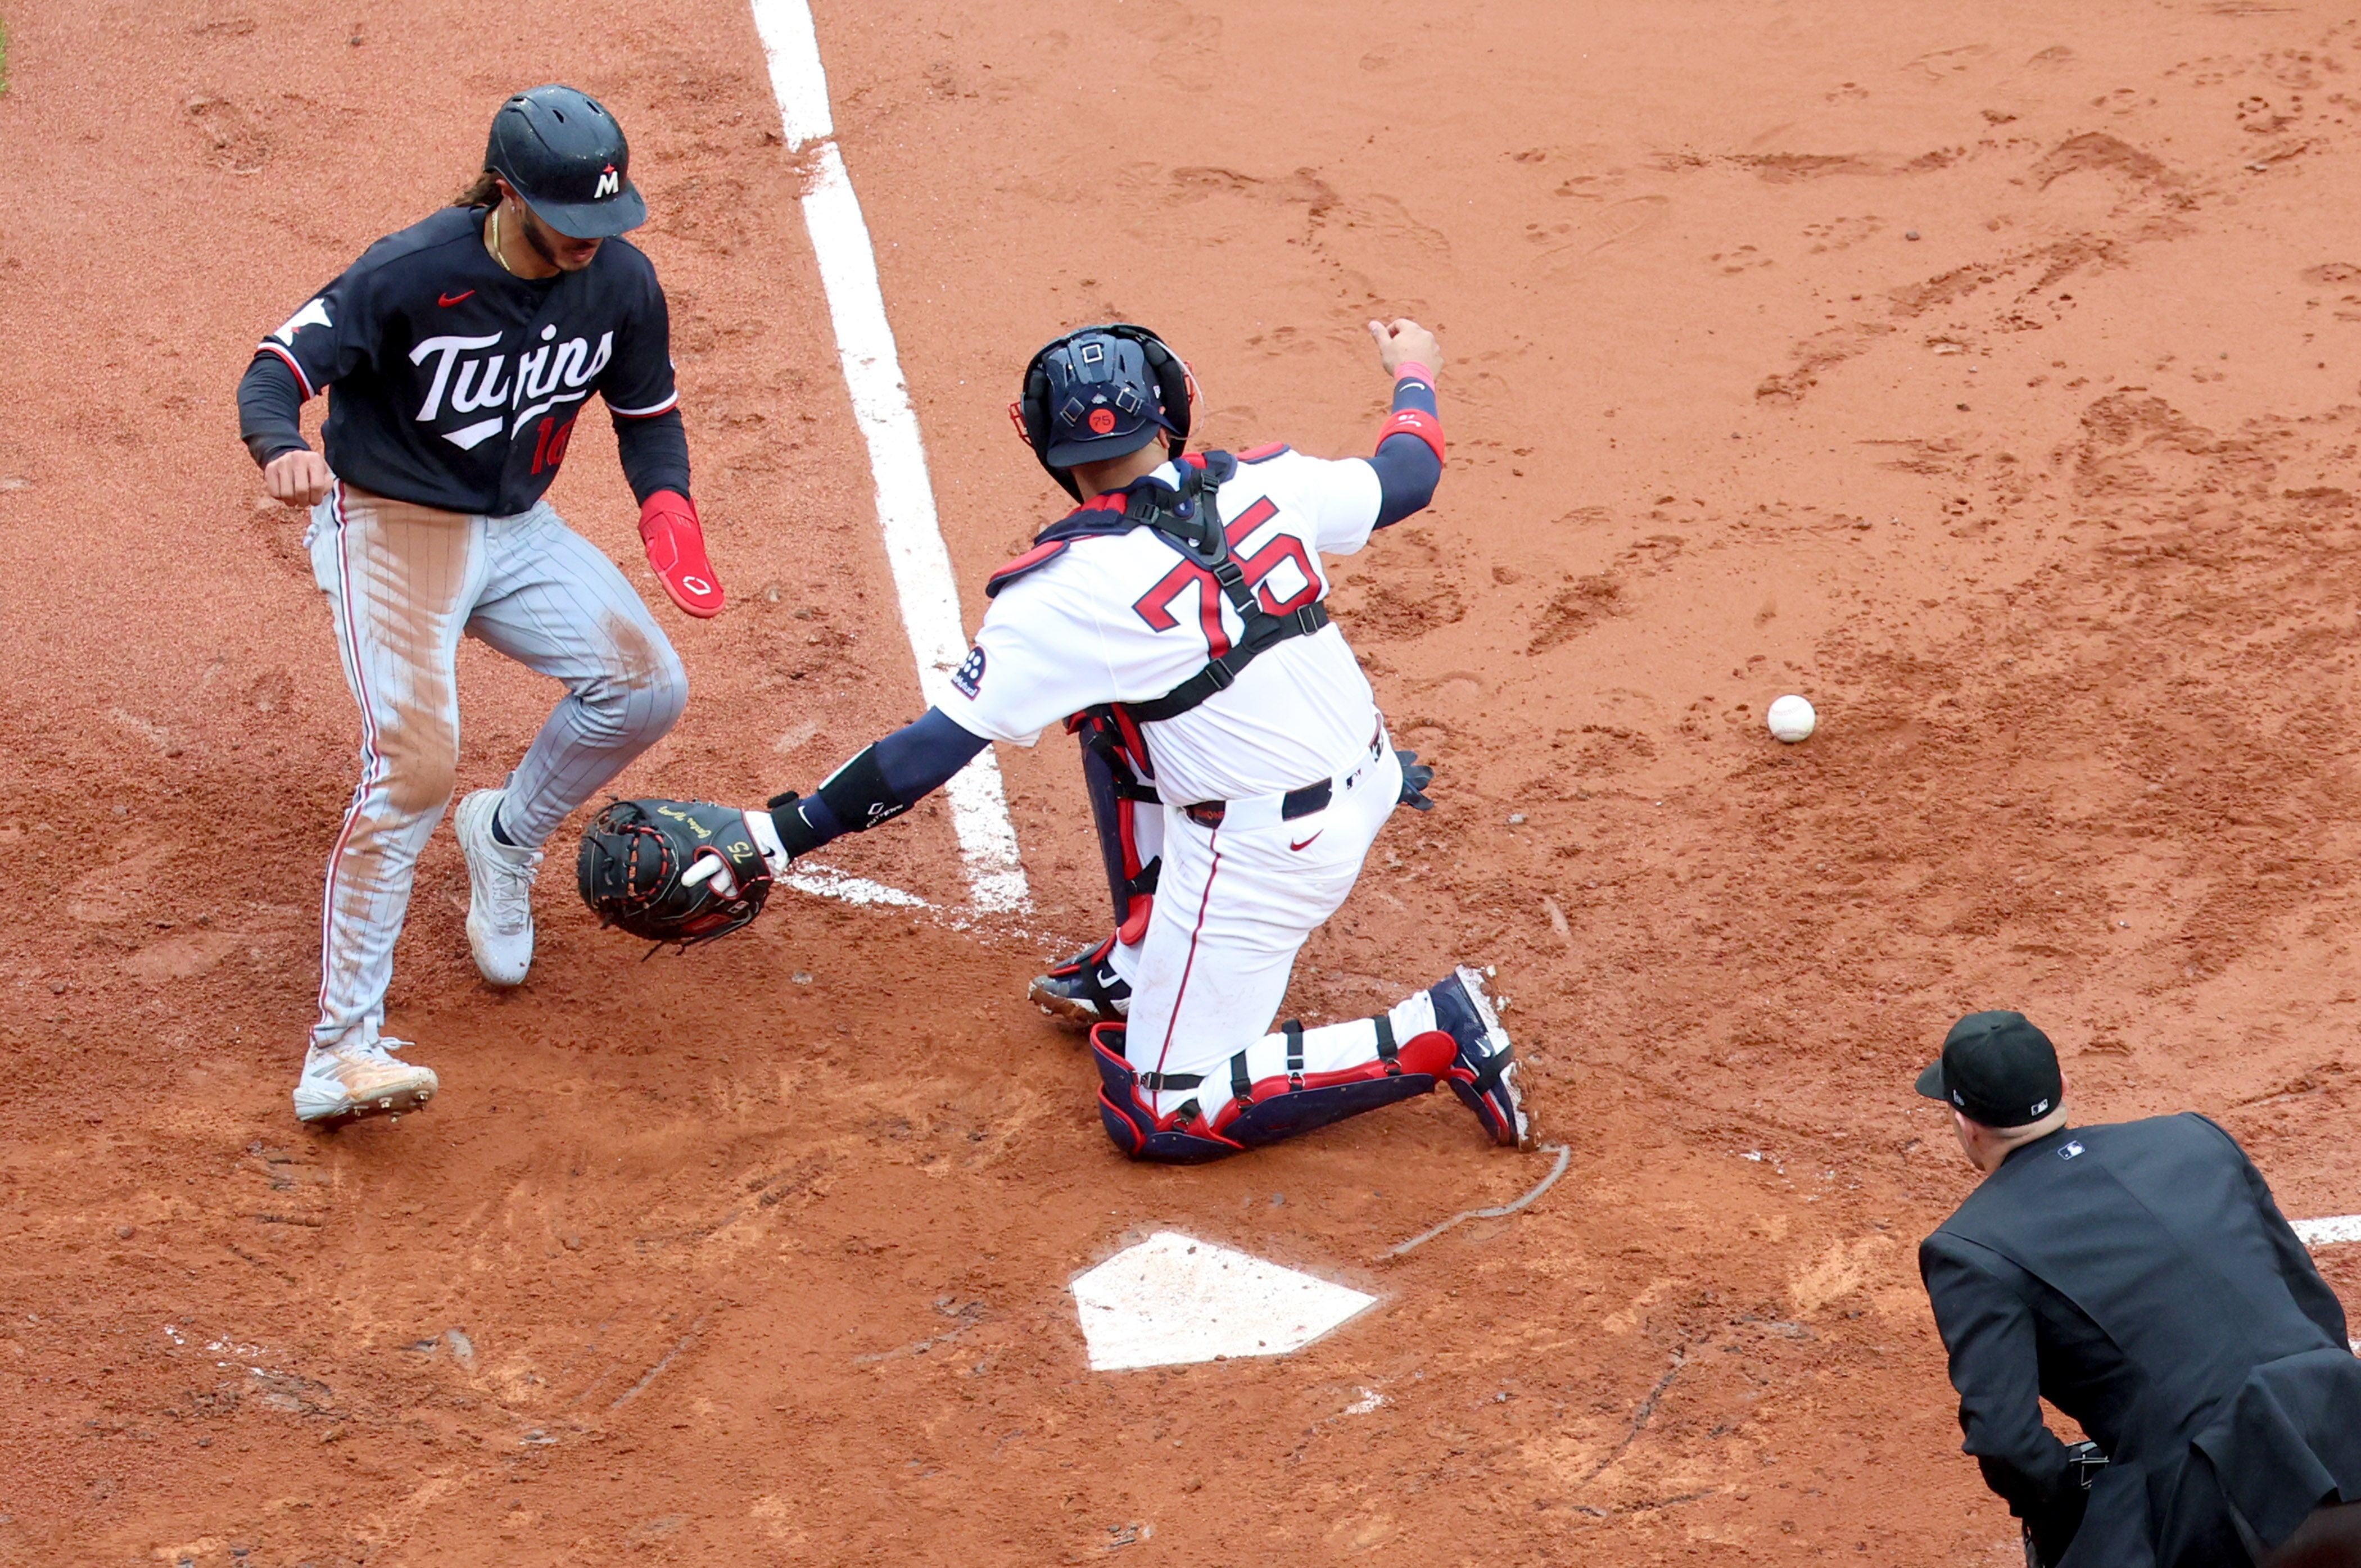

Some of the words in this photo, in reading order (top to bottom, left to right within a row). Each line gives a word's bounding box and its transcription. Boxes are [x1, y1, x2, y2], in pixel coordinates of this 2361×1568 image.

[594, 170, 618, 198] M
[409, 324, 614, 422] Twins
[1092, 415, 1111, 427] 75
[1131, 494, 1322, 659] 75
[726, 841, 753, 864] 75
